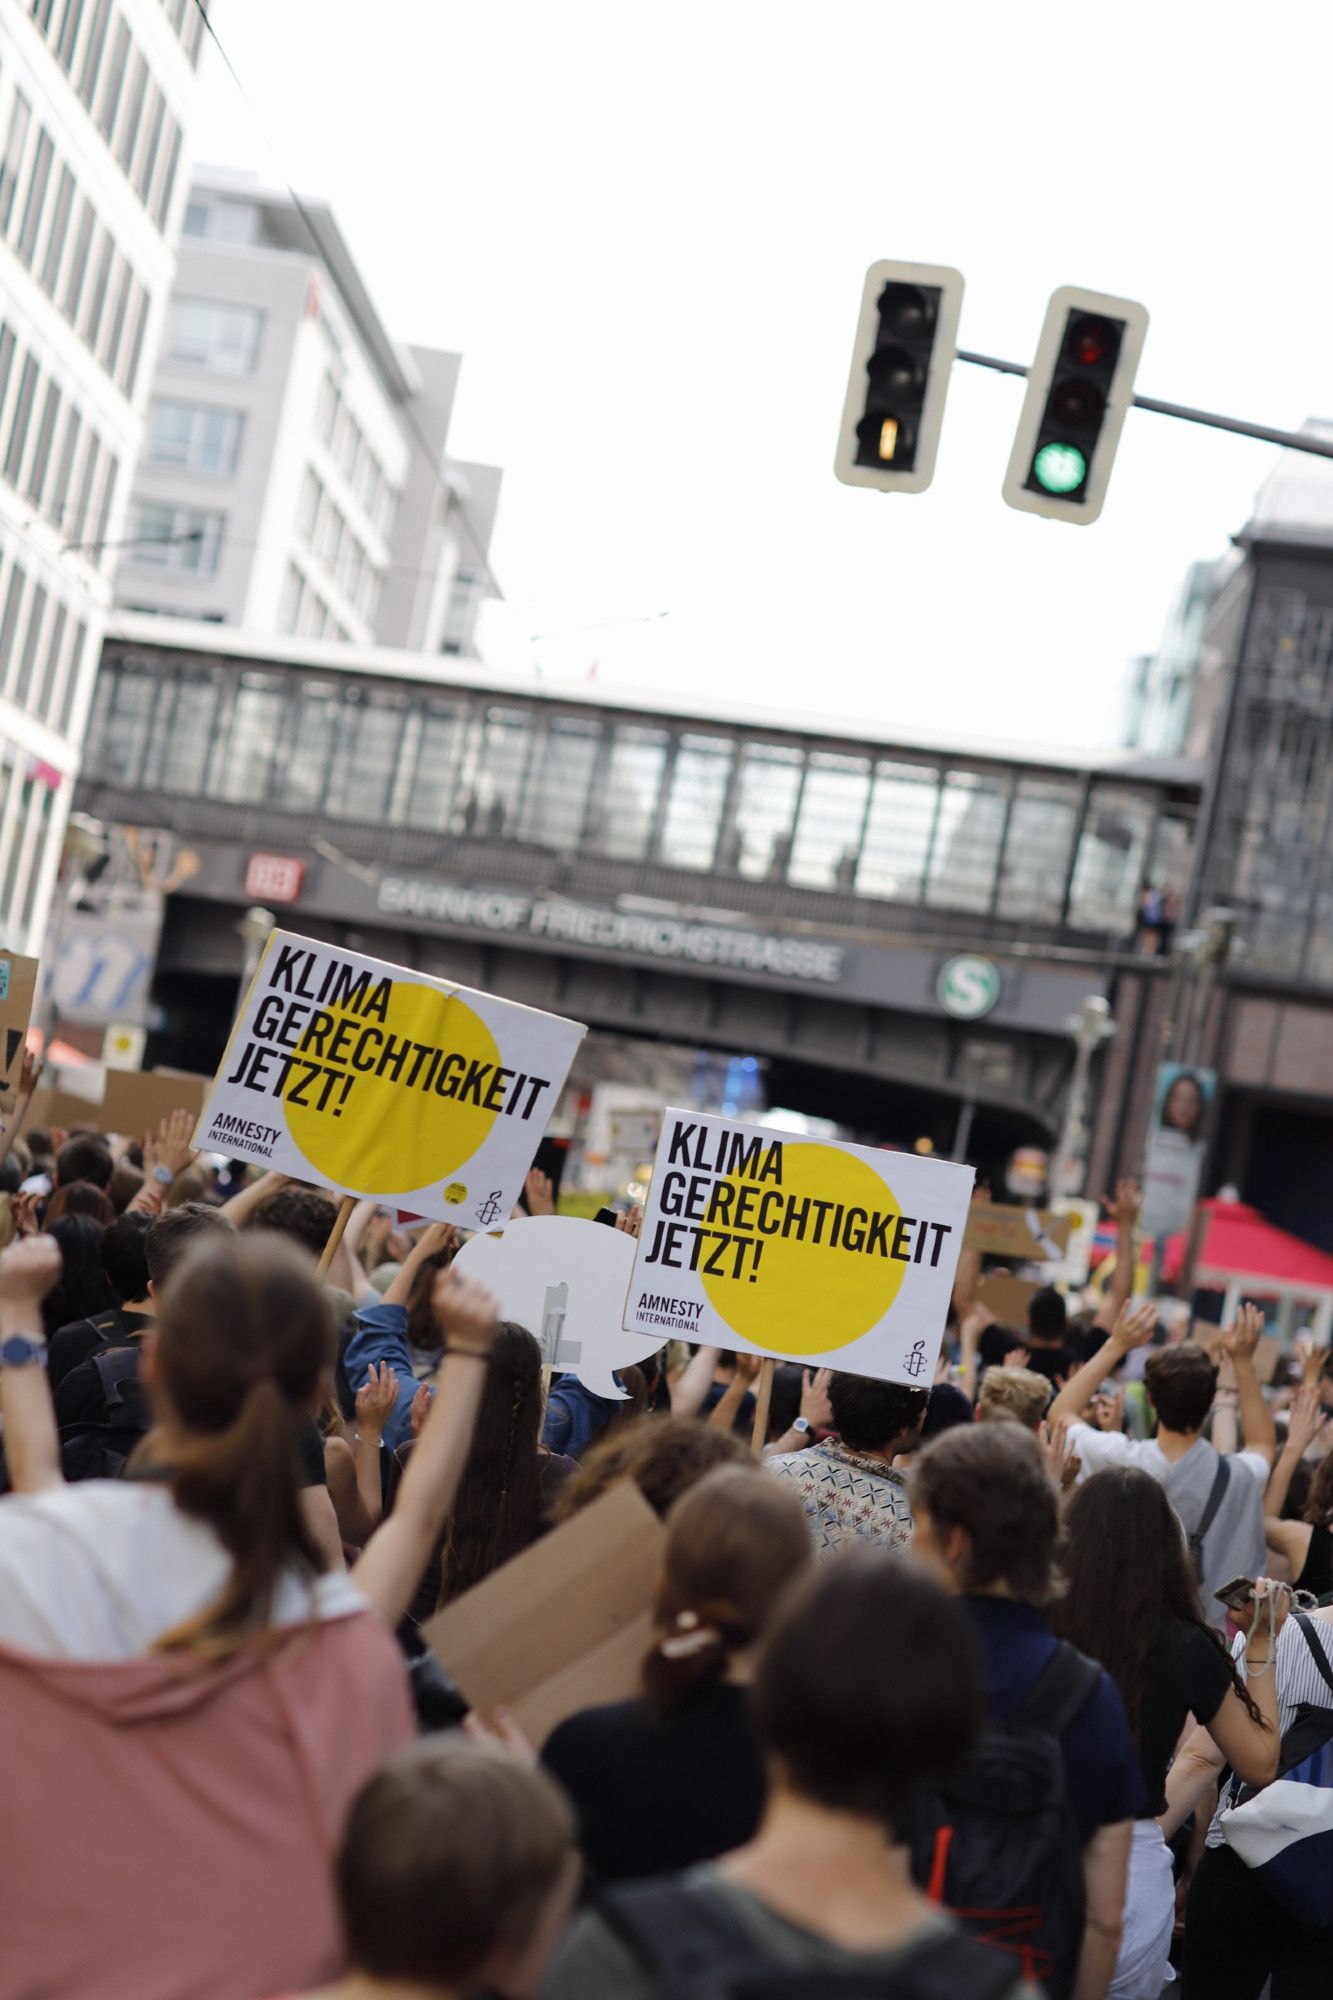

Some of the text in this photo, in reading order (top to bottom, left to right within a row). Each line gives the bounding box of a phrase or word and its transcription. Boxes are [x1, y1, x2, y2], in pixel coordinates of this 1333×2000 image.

[377, 877, 532, 930] BAHNHOF
[268, 944, 393, 1024] KLIMA
[943, 959, 991, 1013] S
[227, 1042, 356, 1118] JETZT!
[252, 994, 551, 1121] GERECHTIGKEIT
[207, 1130, 273, 1158] INTERNATIONAL
[212, 1112, 282, 1146] AMNESTY
[667, 1121, 783, 1186] KLIMA
[659, 1171, 952, 1268] GERECHTIGKEIT
[644, 1220, 765, 1283] JETZT!
[635, 1311, 700, 1333] INTERNATIONAL
[638, 1293, 704, 1319] AMNESTY
